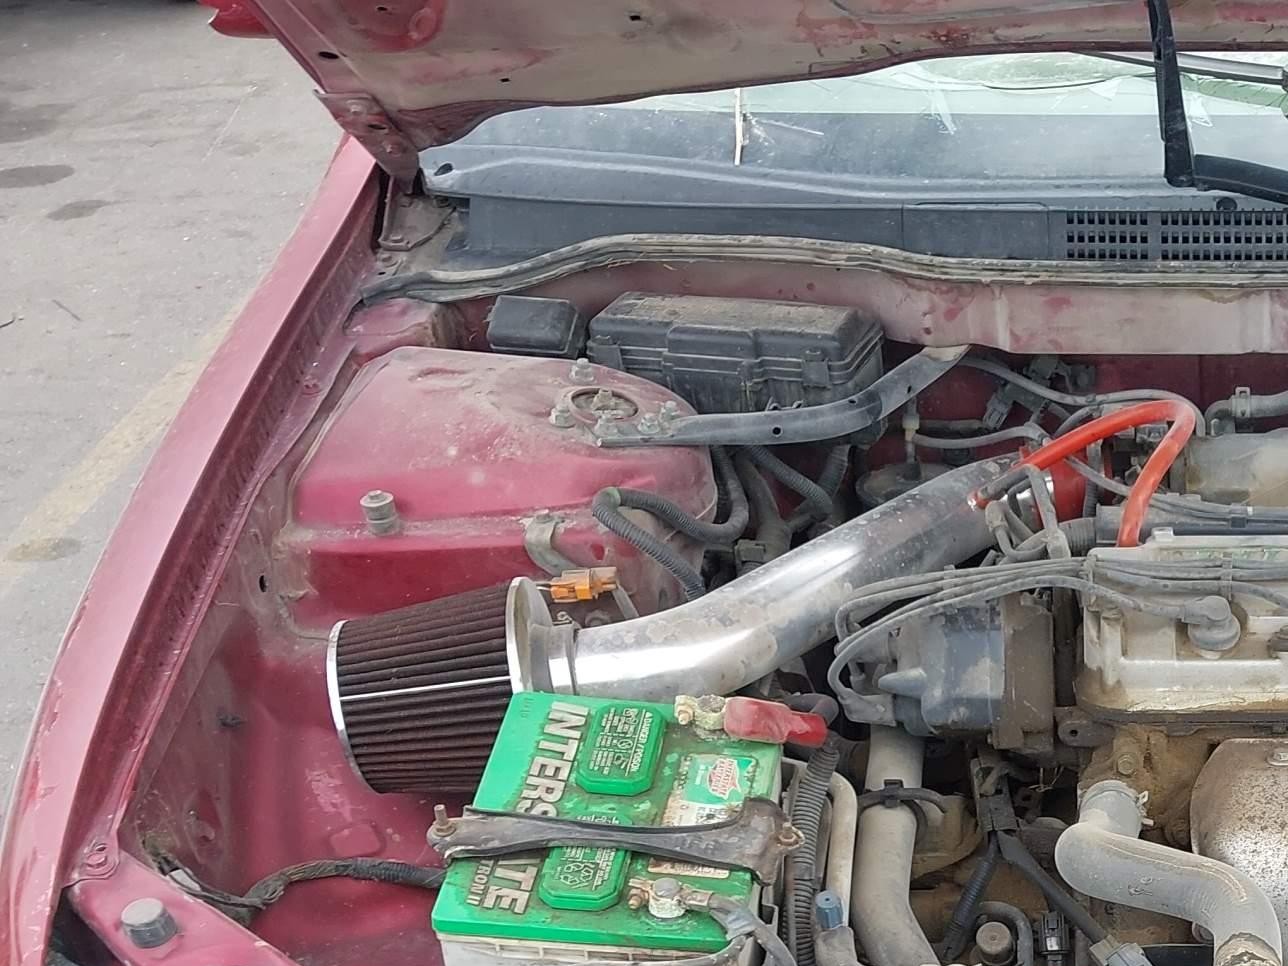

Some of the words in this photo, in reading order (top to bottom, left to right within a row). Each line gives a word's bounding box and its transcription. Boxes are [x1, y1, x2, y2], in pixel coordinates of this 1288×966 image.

[639, 718, 652, 743] DANGER
[631, 748, 644, 771] POISON
[482, 701, 588, 913] INTERSTE
